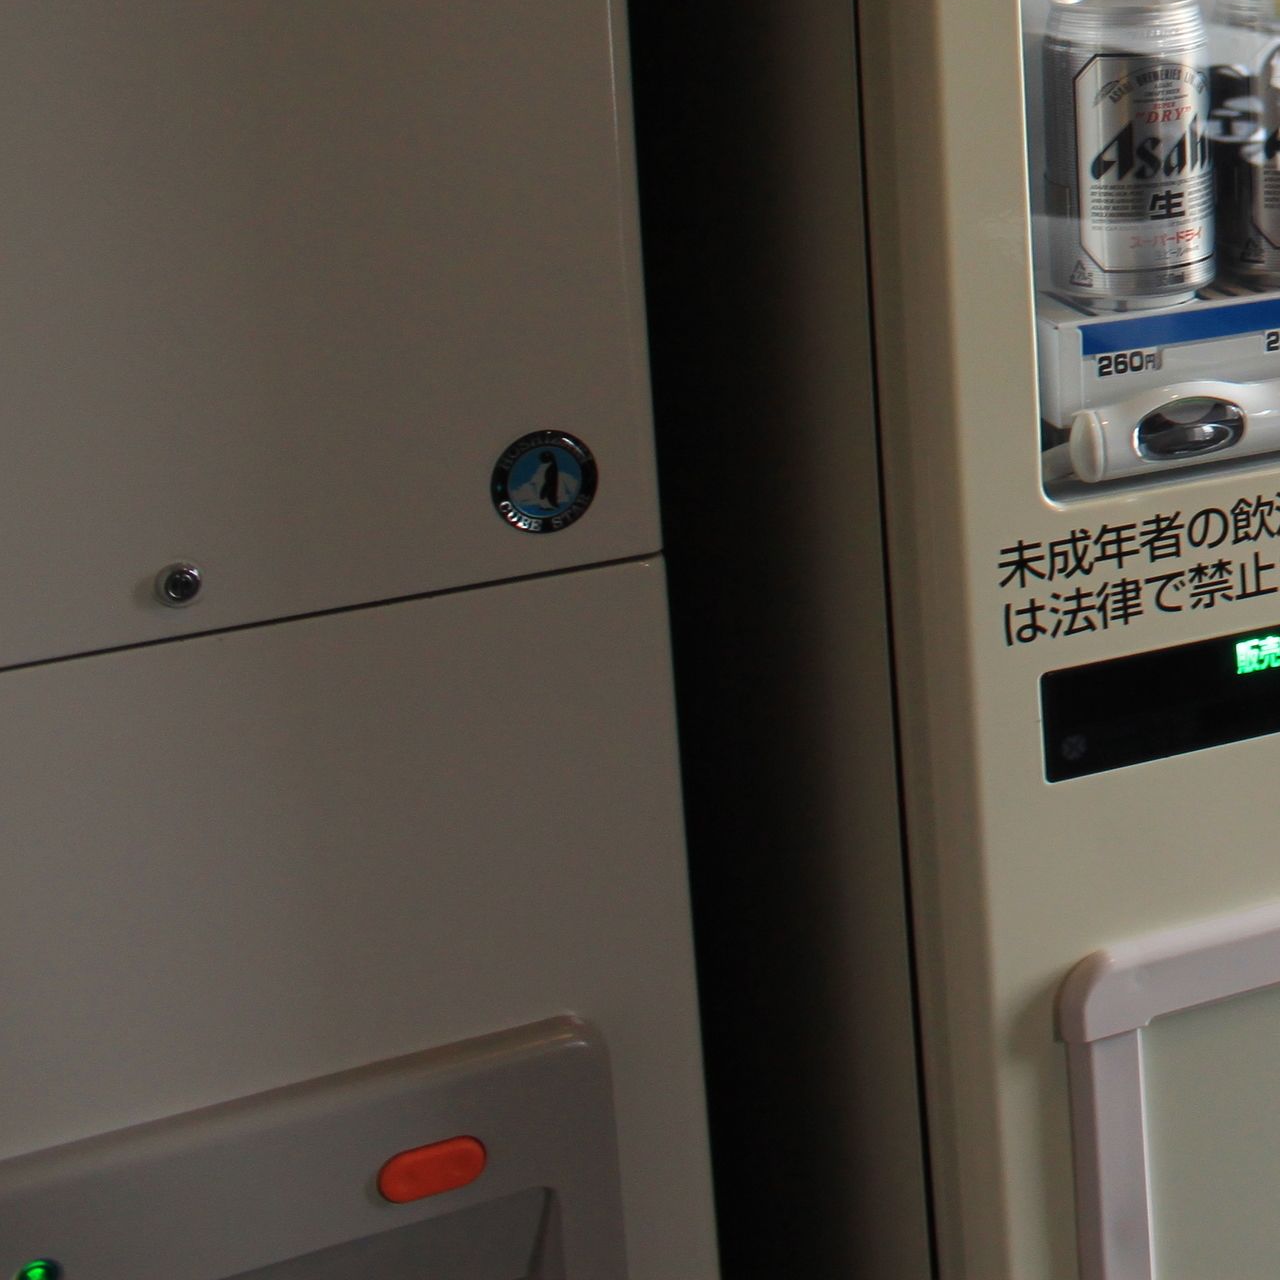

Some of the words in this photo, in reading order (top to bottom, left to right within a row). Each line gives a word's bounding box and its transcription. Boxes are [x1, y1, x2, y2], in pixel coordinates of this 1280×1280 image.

[1149, 189, 1185, 221] 生
[1097, 351, 1157, 377] 260円
[499, 500, 543, 532] CUBE
